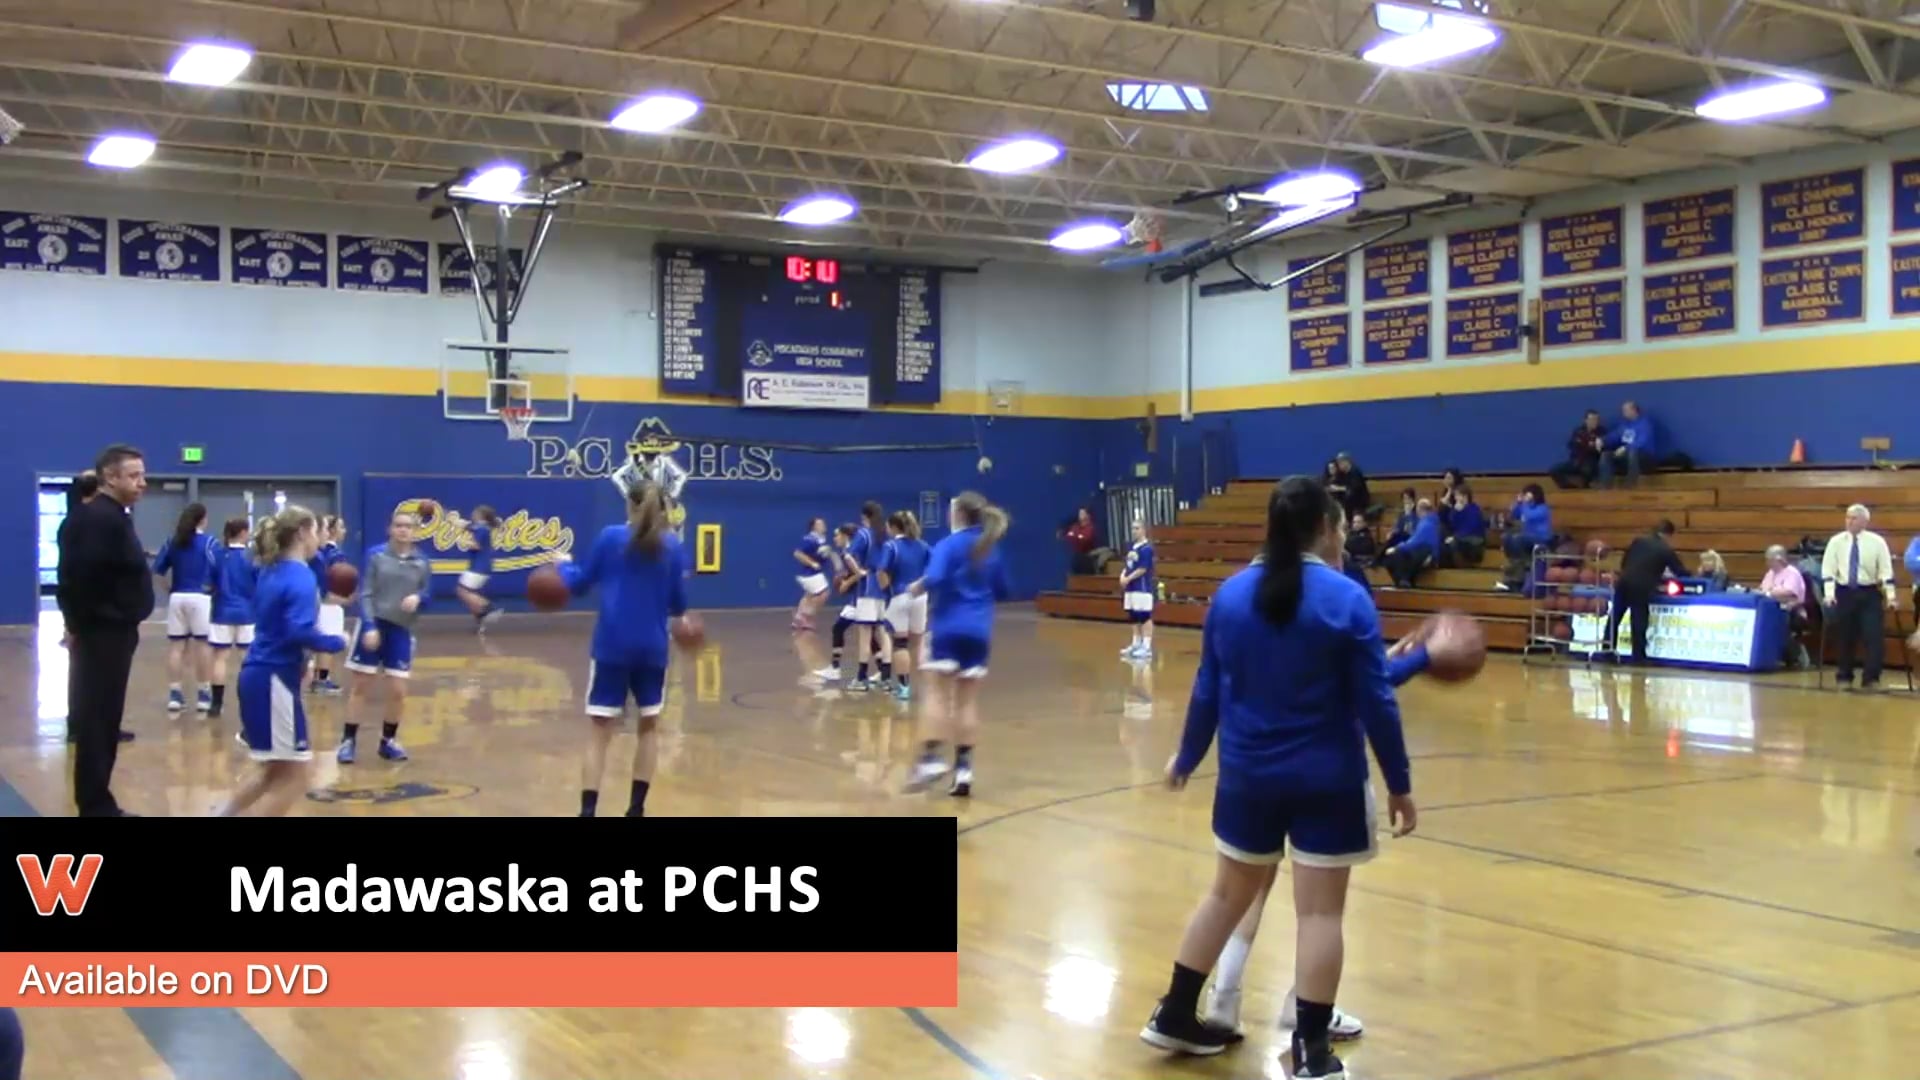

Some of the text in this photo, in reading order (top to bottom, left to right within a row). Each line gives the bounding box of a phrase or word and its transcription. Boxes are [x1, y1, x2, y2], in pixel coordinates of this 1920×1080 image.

[1786, 200, 1839, 219] CLASS C
[1666, 219, 1712, 236] CLASS C
[1771, 212, 1856, 234] FIELD HOCKEY
[1548, 232, 1616, 253] BOYS CLASS C
[1662, 233, 1715, 248] SOFTBALL
[1453, 247, 1516, 267] BOYS CLASS C
[1390, 263, 1416, 275] CLASS
[1418, 262, 1424, 272] C
[1786, 280, 1839, 297] CLASS C
[831, 291, 838, 307] 1
[1666, 295, 1712, 311] CLASS C
[1782, 296, 1843, 310] BASEBALL
[1562, 306, 1603, 321] CLASS C
[1652, 307, 1726, 324] FIELD HOCKEY
[1390, 327, 1416, 338] CLASS
[1417, 326, 1424, 336] C
[1464, 318, 1501, 332] CLASS C
[1558, 320, 1606, 332] SOFTBALL
[821, 346, 864, 358] COMMUNITY
[816, 358, 843, 368] SCHOOL
